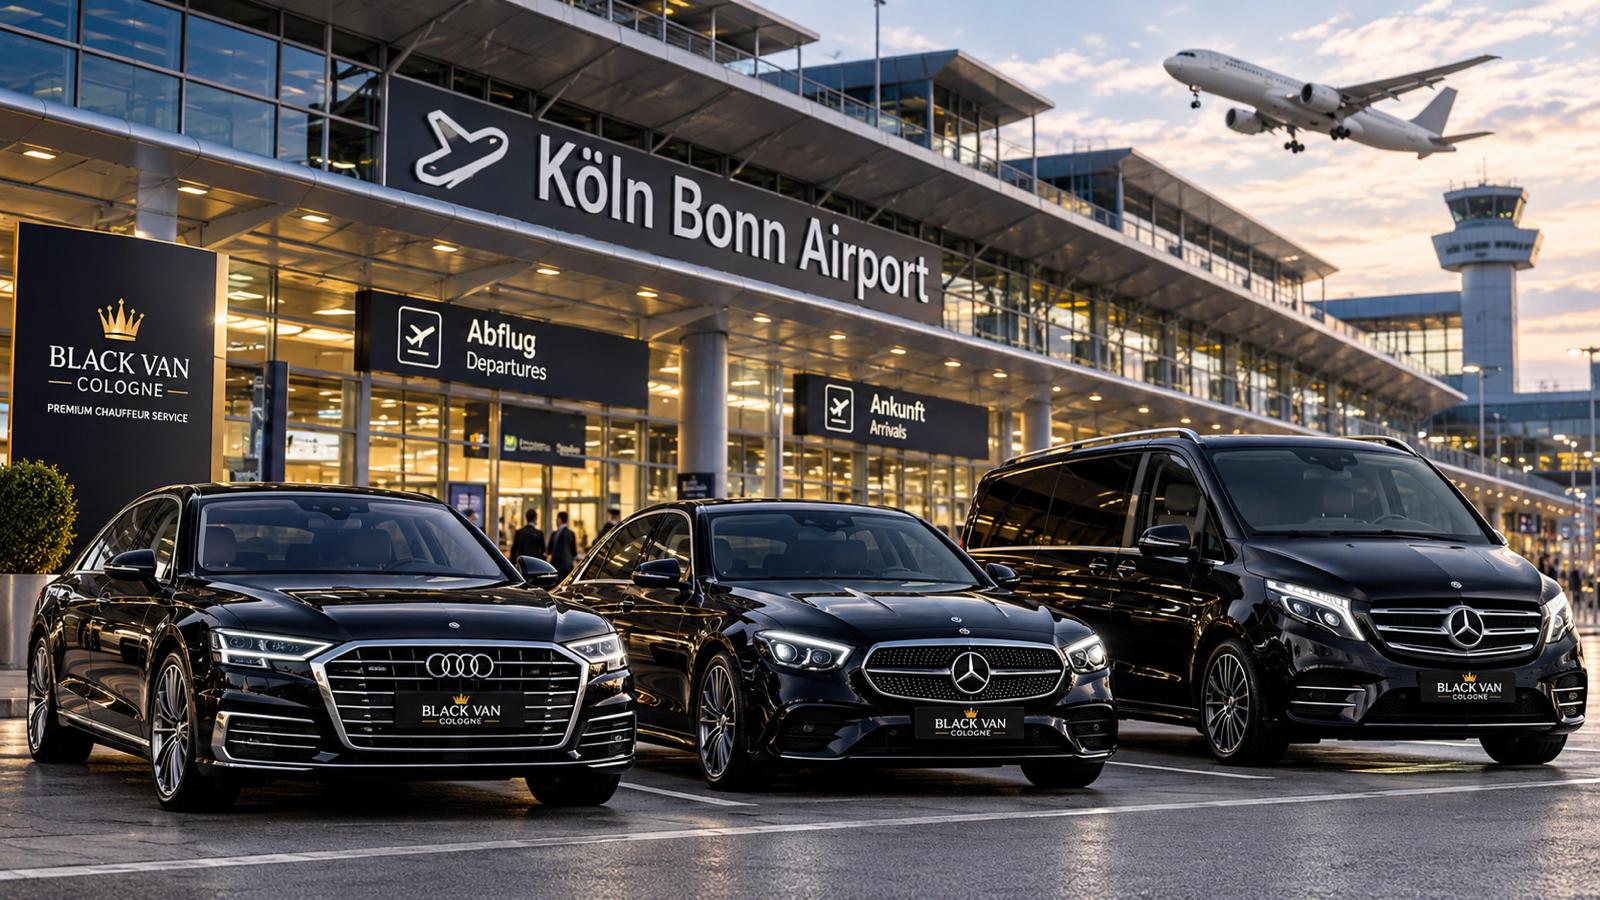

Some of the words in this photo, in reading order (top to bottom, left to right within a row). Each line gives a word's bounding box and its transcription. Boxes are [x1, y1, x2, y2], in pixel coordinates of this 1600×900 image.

[538, 134, 653, 229] Köln
[673, 175, 786, 264] Bonn
[799, 217, 929, 304] Airport
[467, 319, 536, 359] Abflug
[49, 345, 135, 375] BLACK
[141, 353, 190, 380] VAN
[466, 351, 547, 381] Departures
[77, 376, 163, 398] COLOGNE
[47, 403, 93, 416] PREMIUM
[95, 407, 150, 420] CHAUFFEUR
[152, 411, 188, 423] SERVICE
[870, 393, 926, 423] Ankunft
[870, 419, 907, 440] Arrivals
[1437, 682, 1476, 693] BLACK
[1479, 682, 1502, 693] VAN
[1452, 693, 1488, 701] COLOGNE
[422, 705, 469, 717] BLACK
[473, 705, 501, 717] VAN
[439, 717, 482, 725] COLOGNE
[935, 718, 978, 729] BLACK
[981, 718, 1006, 729] VAN
[950, 729, 991, 737] COLOGNE
